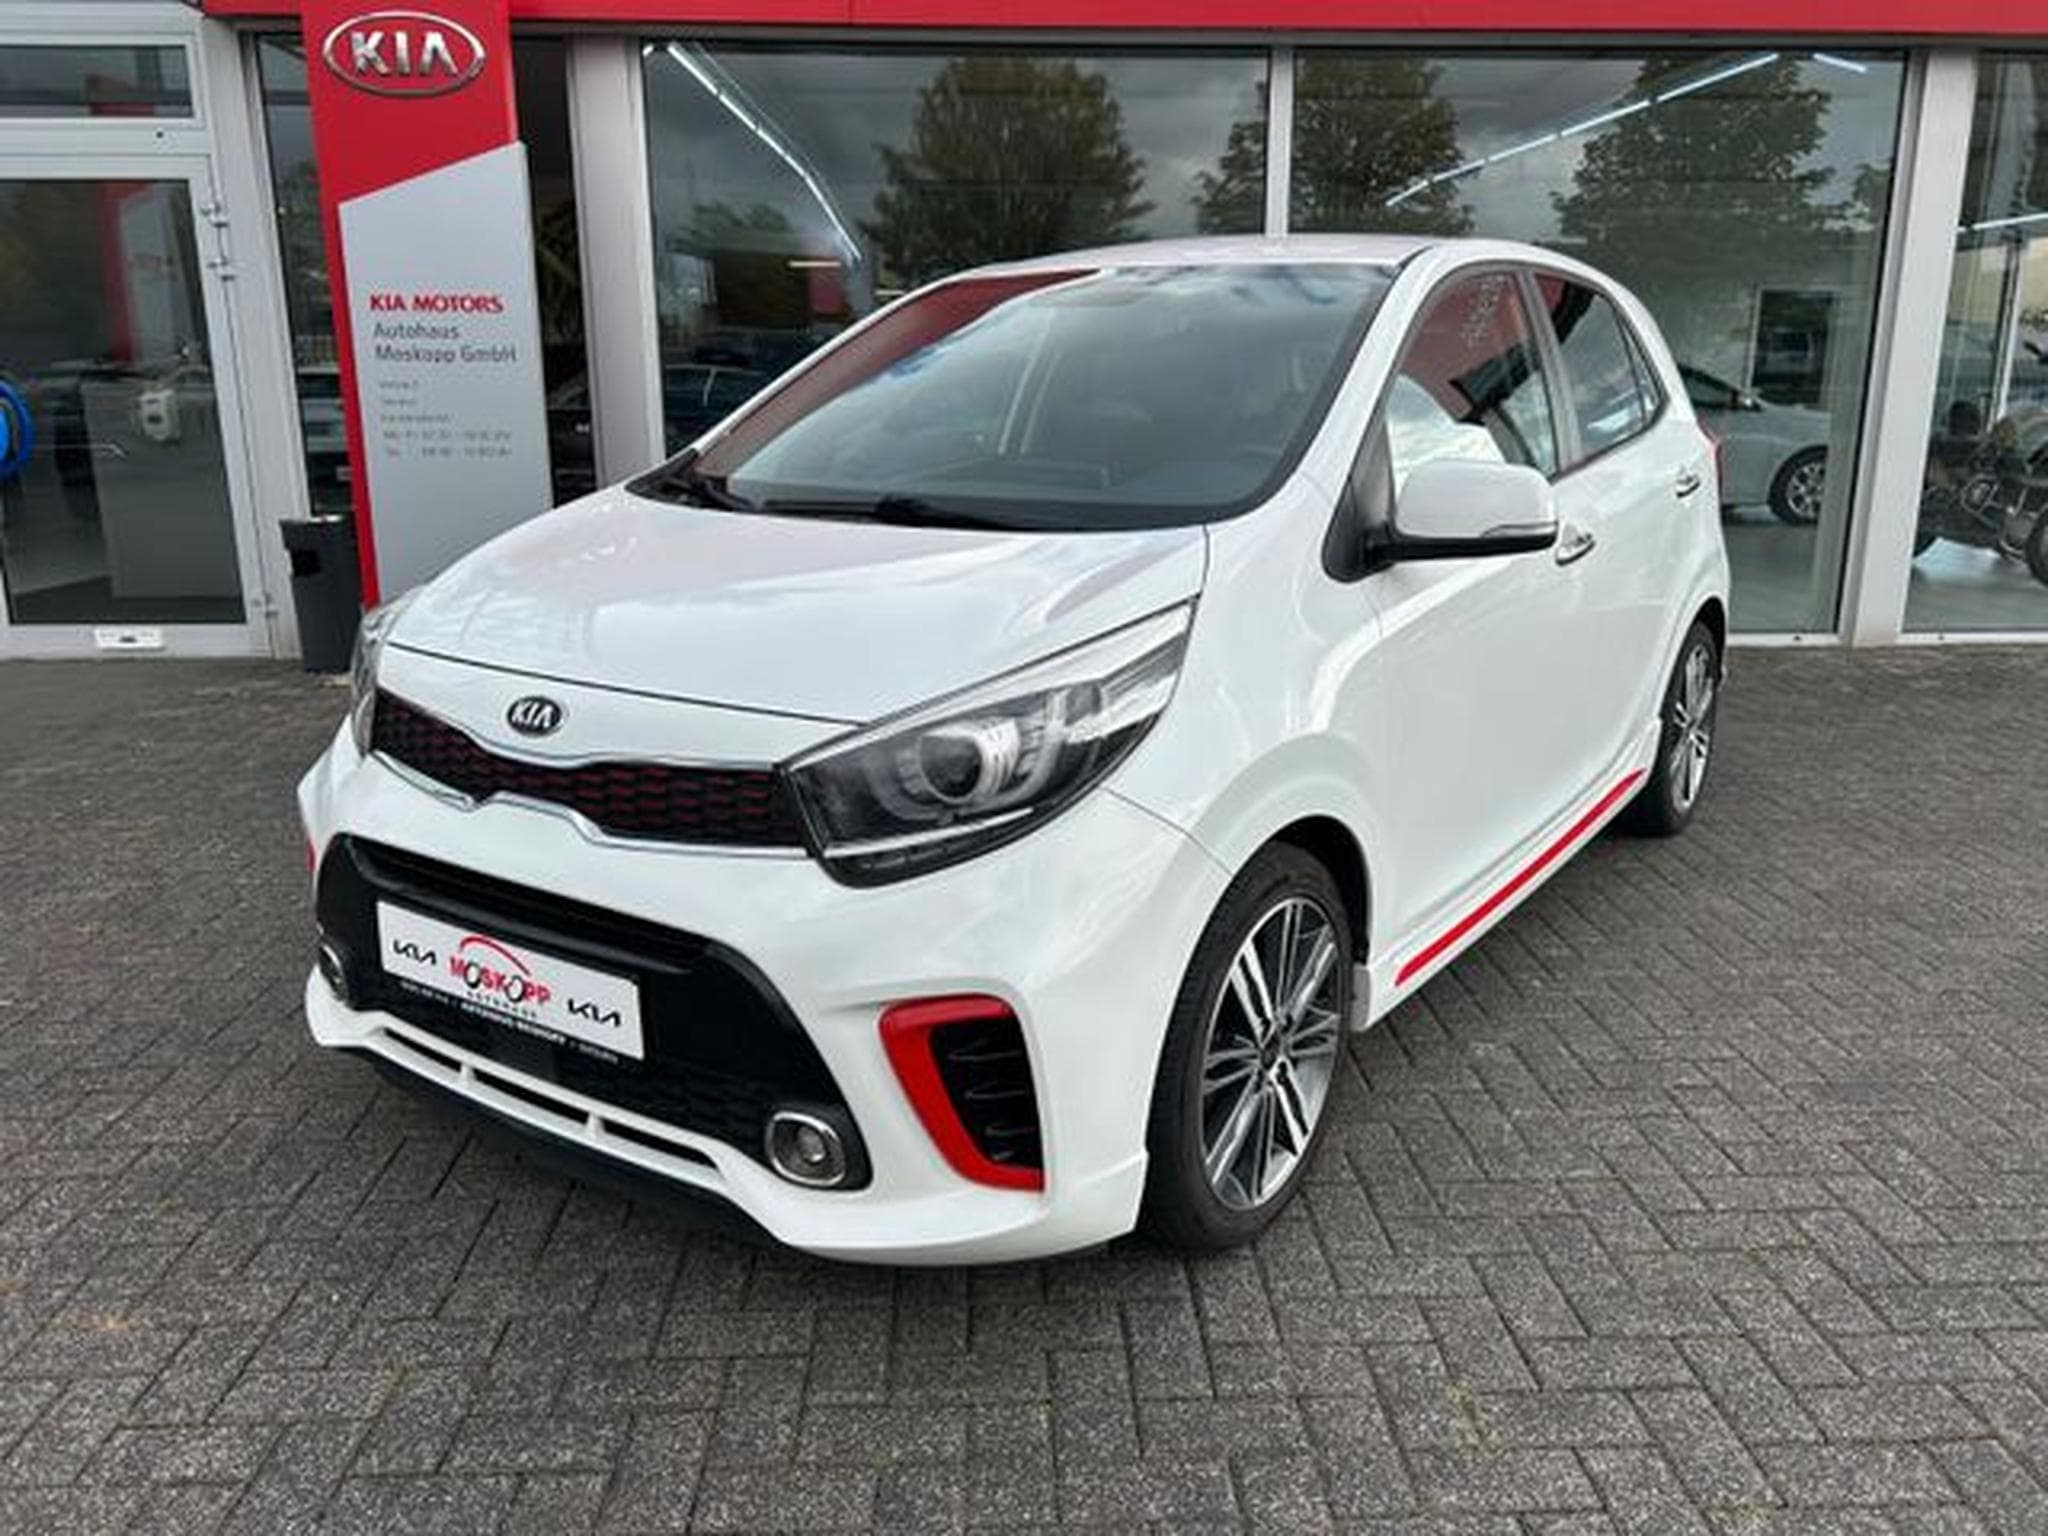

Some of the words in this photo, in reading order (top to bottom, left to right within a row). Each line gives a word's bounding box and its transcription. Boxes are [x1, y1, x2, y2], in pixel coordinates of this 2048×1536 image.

[351, 31, 459, 77] KIA
[370, 294, 407, 312] KIA
[412, 294, 504, 313] MOTORS
[373, 322, 460, 340] Autohaus
[375, 344, 456, 363] Moskopp
[460, 345, 518, 363] GmbH
[511, 701, 553, 728] KIA
[450, 956, 551, 1003] MOSKOPP
[567, 998, 621, 1028] KIA
